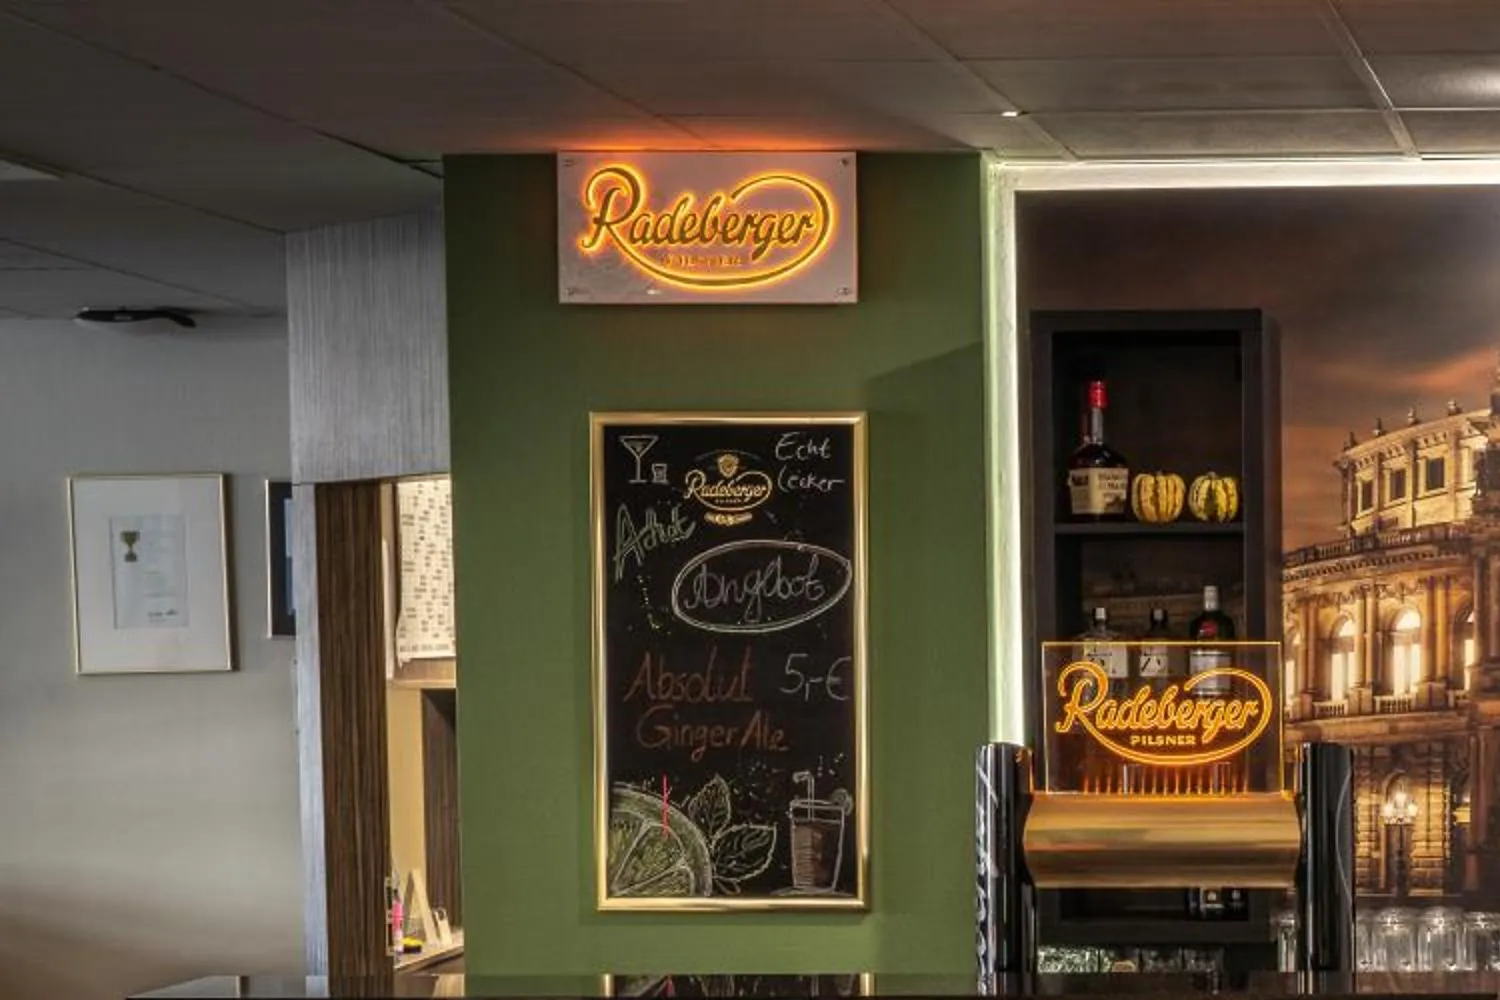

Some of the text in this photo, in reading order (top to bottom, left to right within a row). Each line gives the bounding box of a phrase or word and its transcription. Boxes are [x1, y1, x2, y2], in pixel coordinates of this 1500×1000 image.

[580, 163, 831, 288] Radeberger
[683, 469, 773, 511] Radeberger
[624, 648, 753, 703] Absolut
[636, 703, 789, 762] Ginger Ale
[1055, 660, 1273, 766] Radeberger
[1130, 734, 1197, 747] PILSNER
